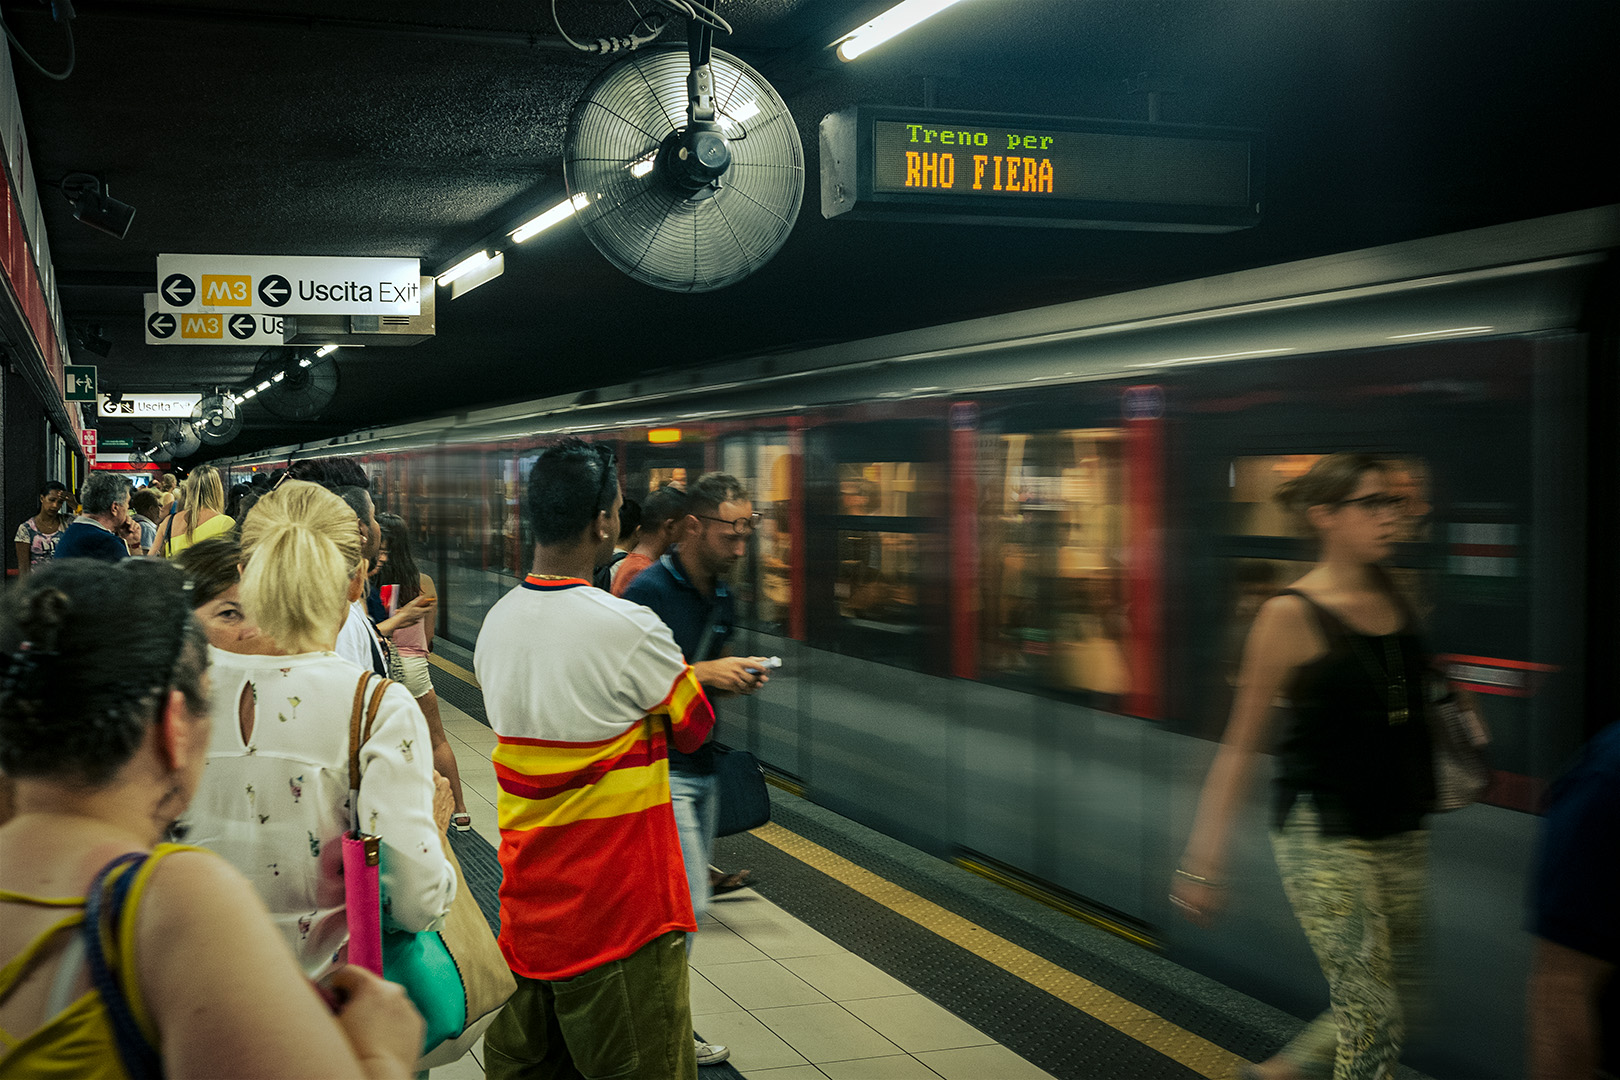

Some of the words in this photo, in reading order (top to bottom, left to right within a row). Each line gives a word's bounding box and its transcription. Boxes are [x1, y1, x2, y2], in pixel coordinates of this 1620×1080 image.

[906, 124, 988, 146] Treno
[1006, 133, 1054, 150] per
[905, 151, 954, 188] RHO
[972, 154, 1053, 193] FIERA
[206, 281, 248, 301] M3
[299, 280, 373, 302] Uscita
[379, 282, 419, 303] Exit
[185, 317, 220, 334] M3
[138, 402, 171, 412] Uscita
